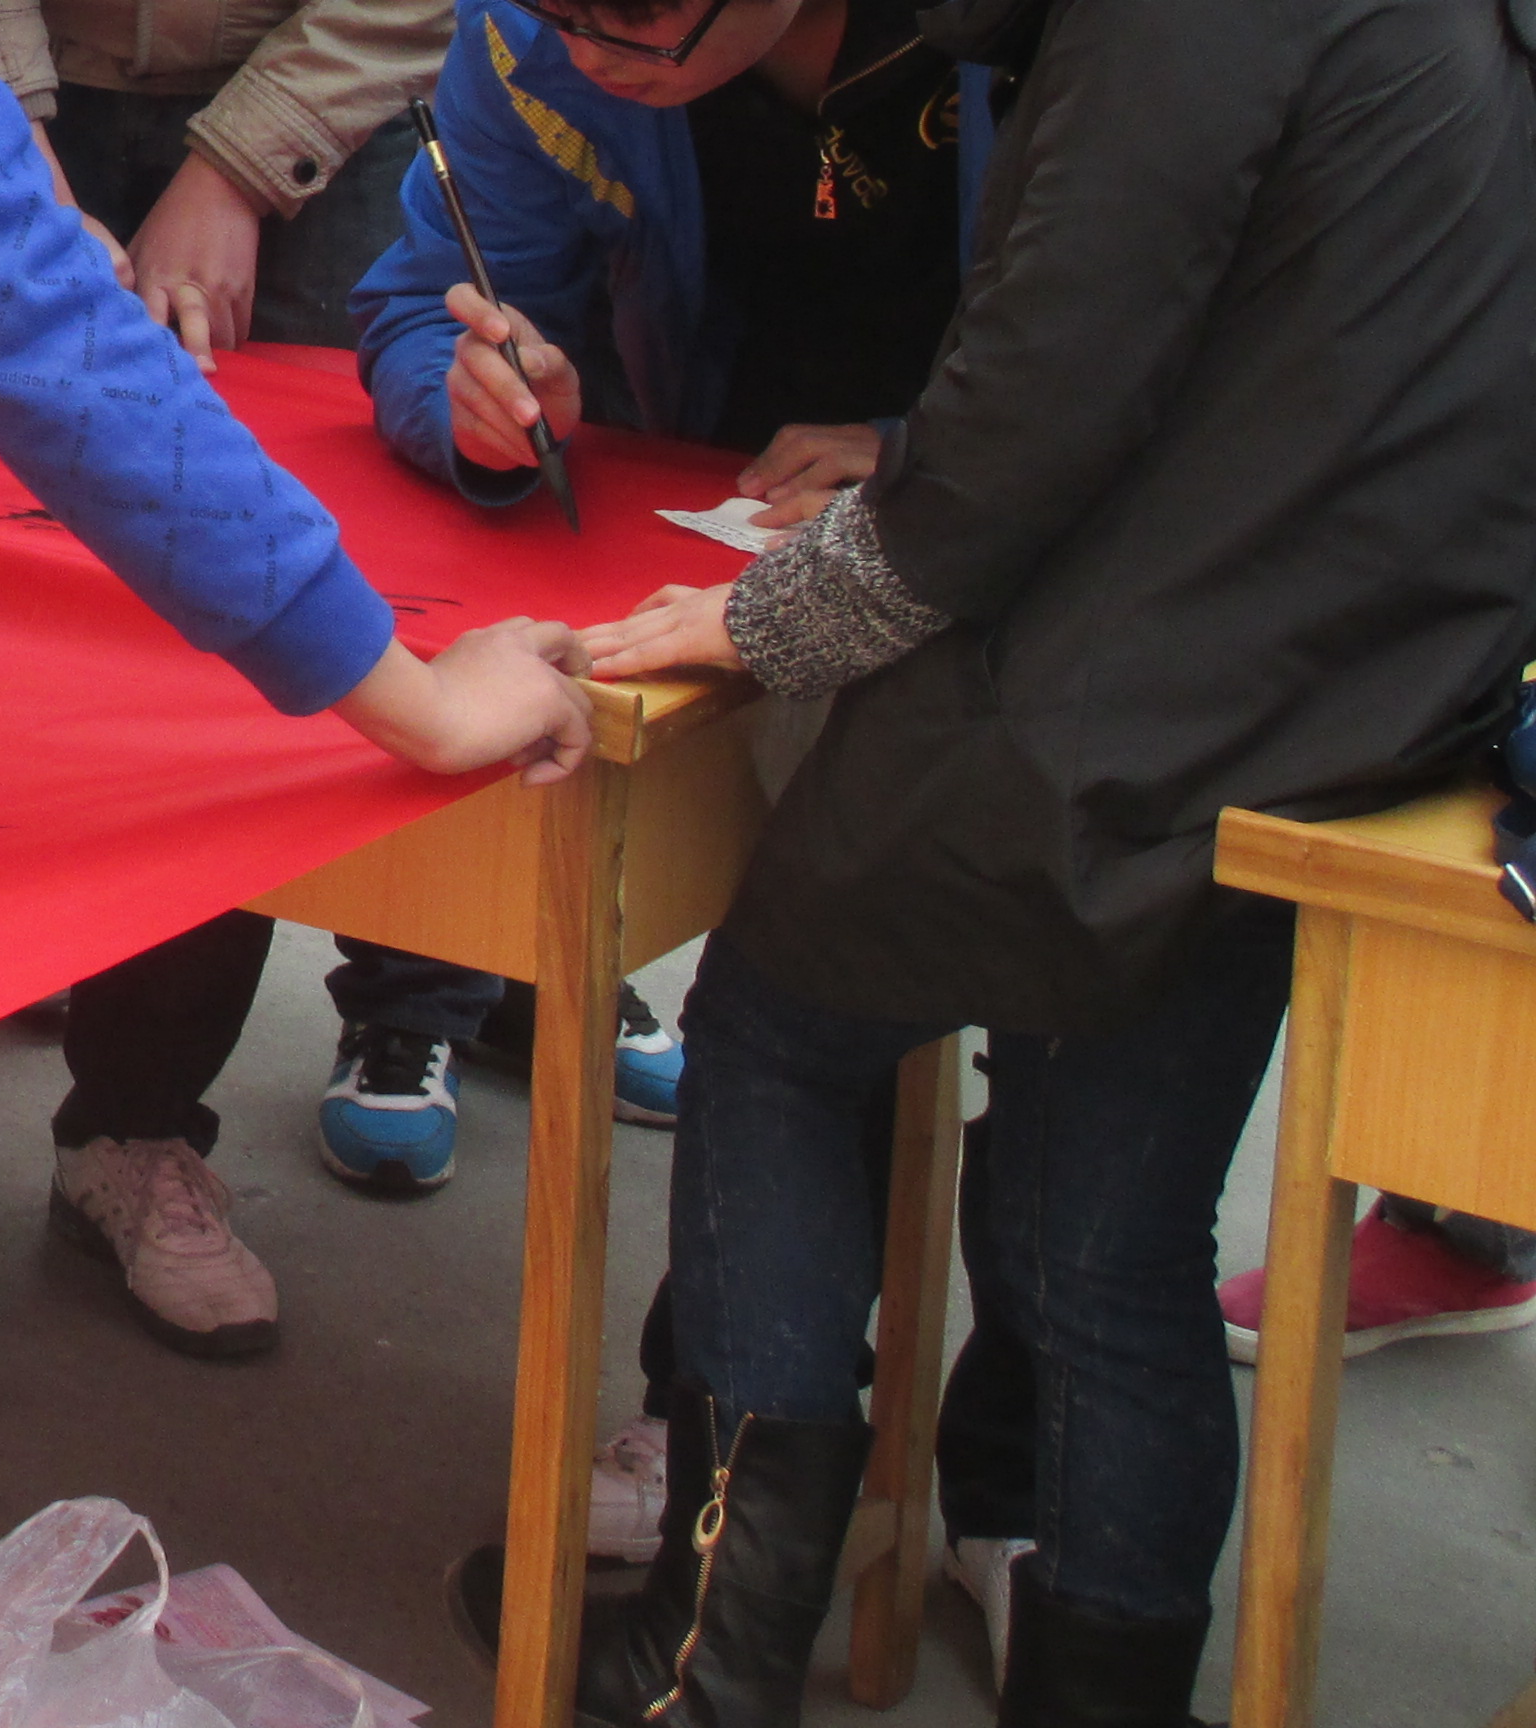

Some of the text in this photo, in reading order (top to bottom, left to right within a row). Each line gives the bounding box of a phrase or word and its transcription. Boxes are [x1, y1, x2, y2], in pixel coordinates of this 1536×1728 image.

[0, 371, 46, 388] adidas
[100, 386, 141, 401] adidas
[264, 560, 276, 608] adidas
